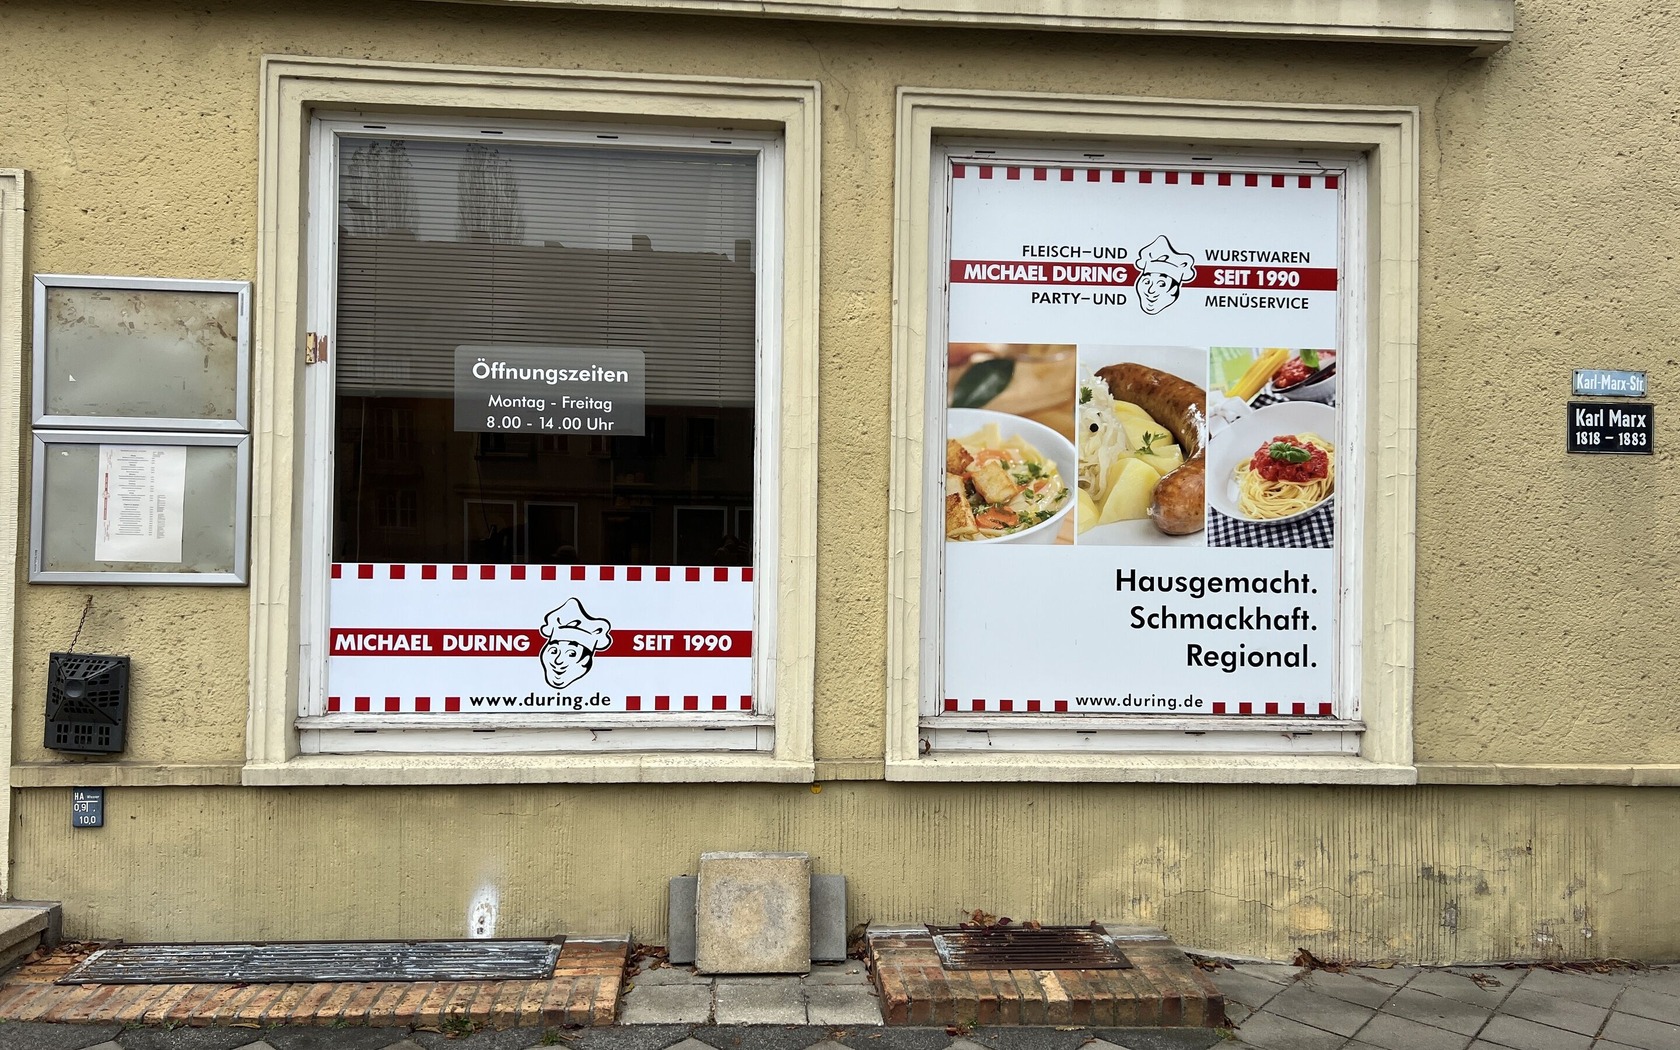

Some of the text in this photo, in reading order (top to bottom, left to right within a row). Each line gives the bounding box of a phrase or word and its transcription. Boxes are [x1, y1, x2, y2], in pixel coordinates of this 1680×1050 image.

[1205, 249, 1311, 264] WURSTWAREN
[964, 264, 1300, 288] MICHAEL DURING SEIT 1990
[1204, 292, 1309, 310] MENÜSERVICE
[472, 357, 629, 385] Öffnungszeiten
[1576, 373, 1645, 391] Karl-Marx-Str.
[488, 394, 545, 411] Montag
[562, 395, 612, 413] Freitag
[486, 415, 521, 429] 8.00
[587, 417, 615, 431] Uhr
[1576, 408, 1646, 428] Karl Marx
[1576, 431, 1601, 445] 1818
[1618, 432, 1647, 446] 1883
[1116, 568, 1318, 599] Hausgemacht.
[1130, 604, 1317, 631] Schmackhaft.
[334, 633, 732, 652] MICHAEL DURING SEIT 1990
[1187, 643, 1317, 674] Regional.
[470, 691, 612, 711] www.during.de
[1075, 693, 1204, 711] www.during.de
[74, 792, 84, 800] HA
[79, 815, 96, 825] 10,0
